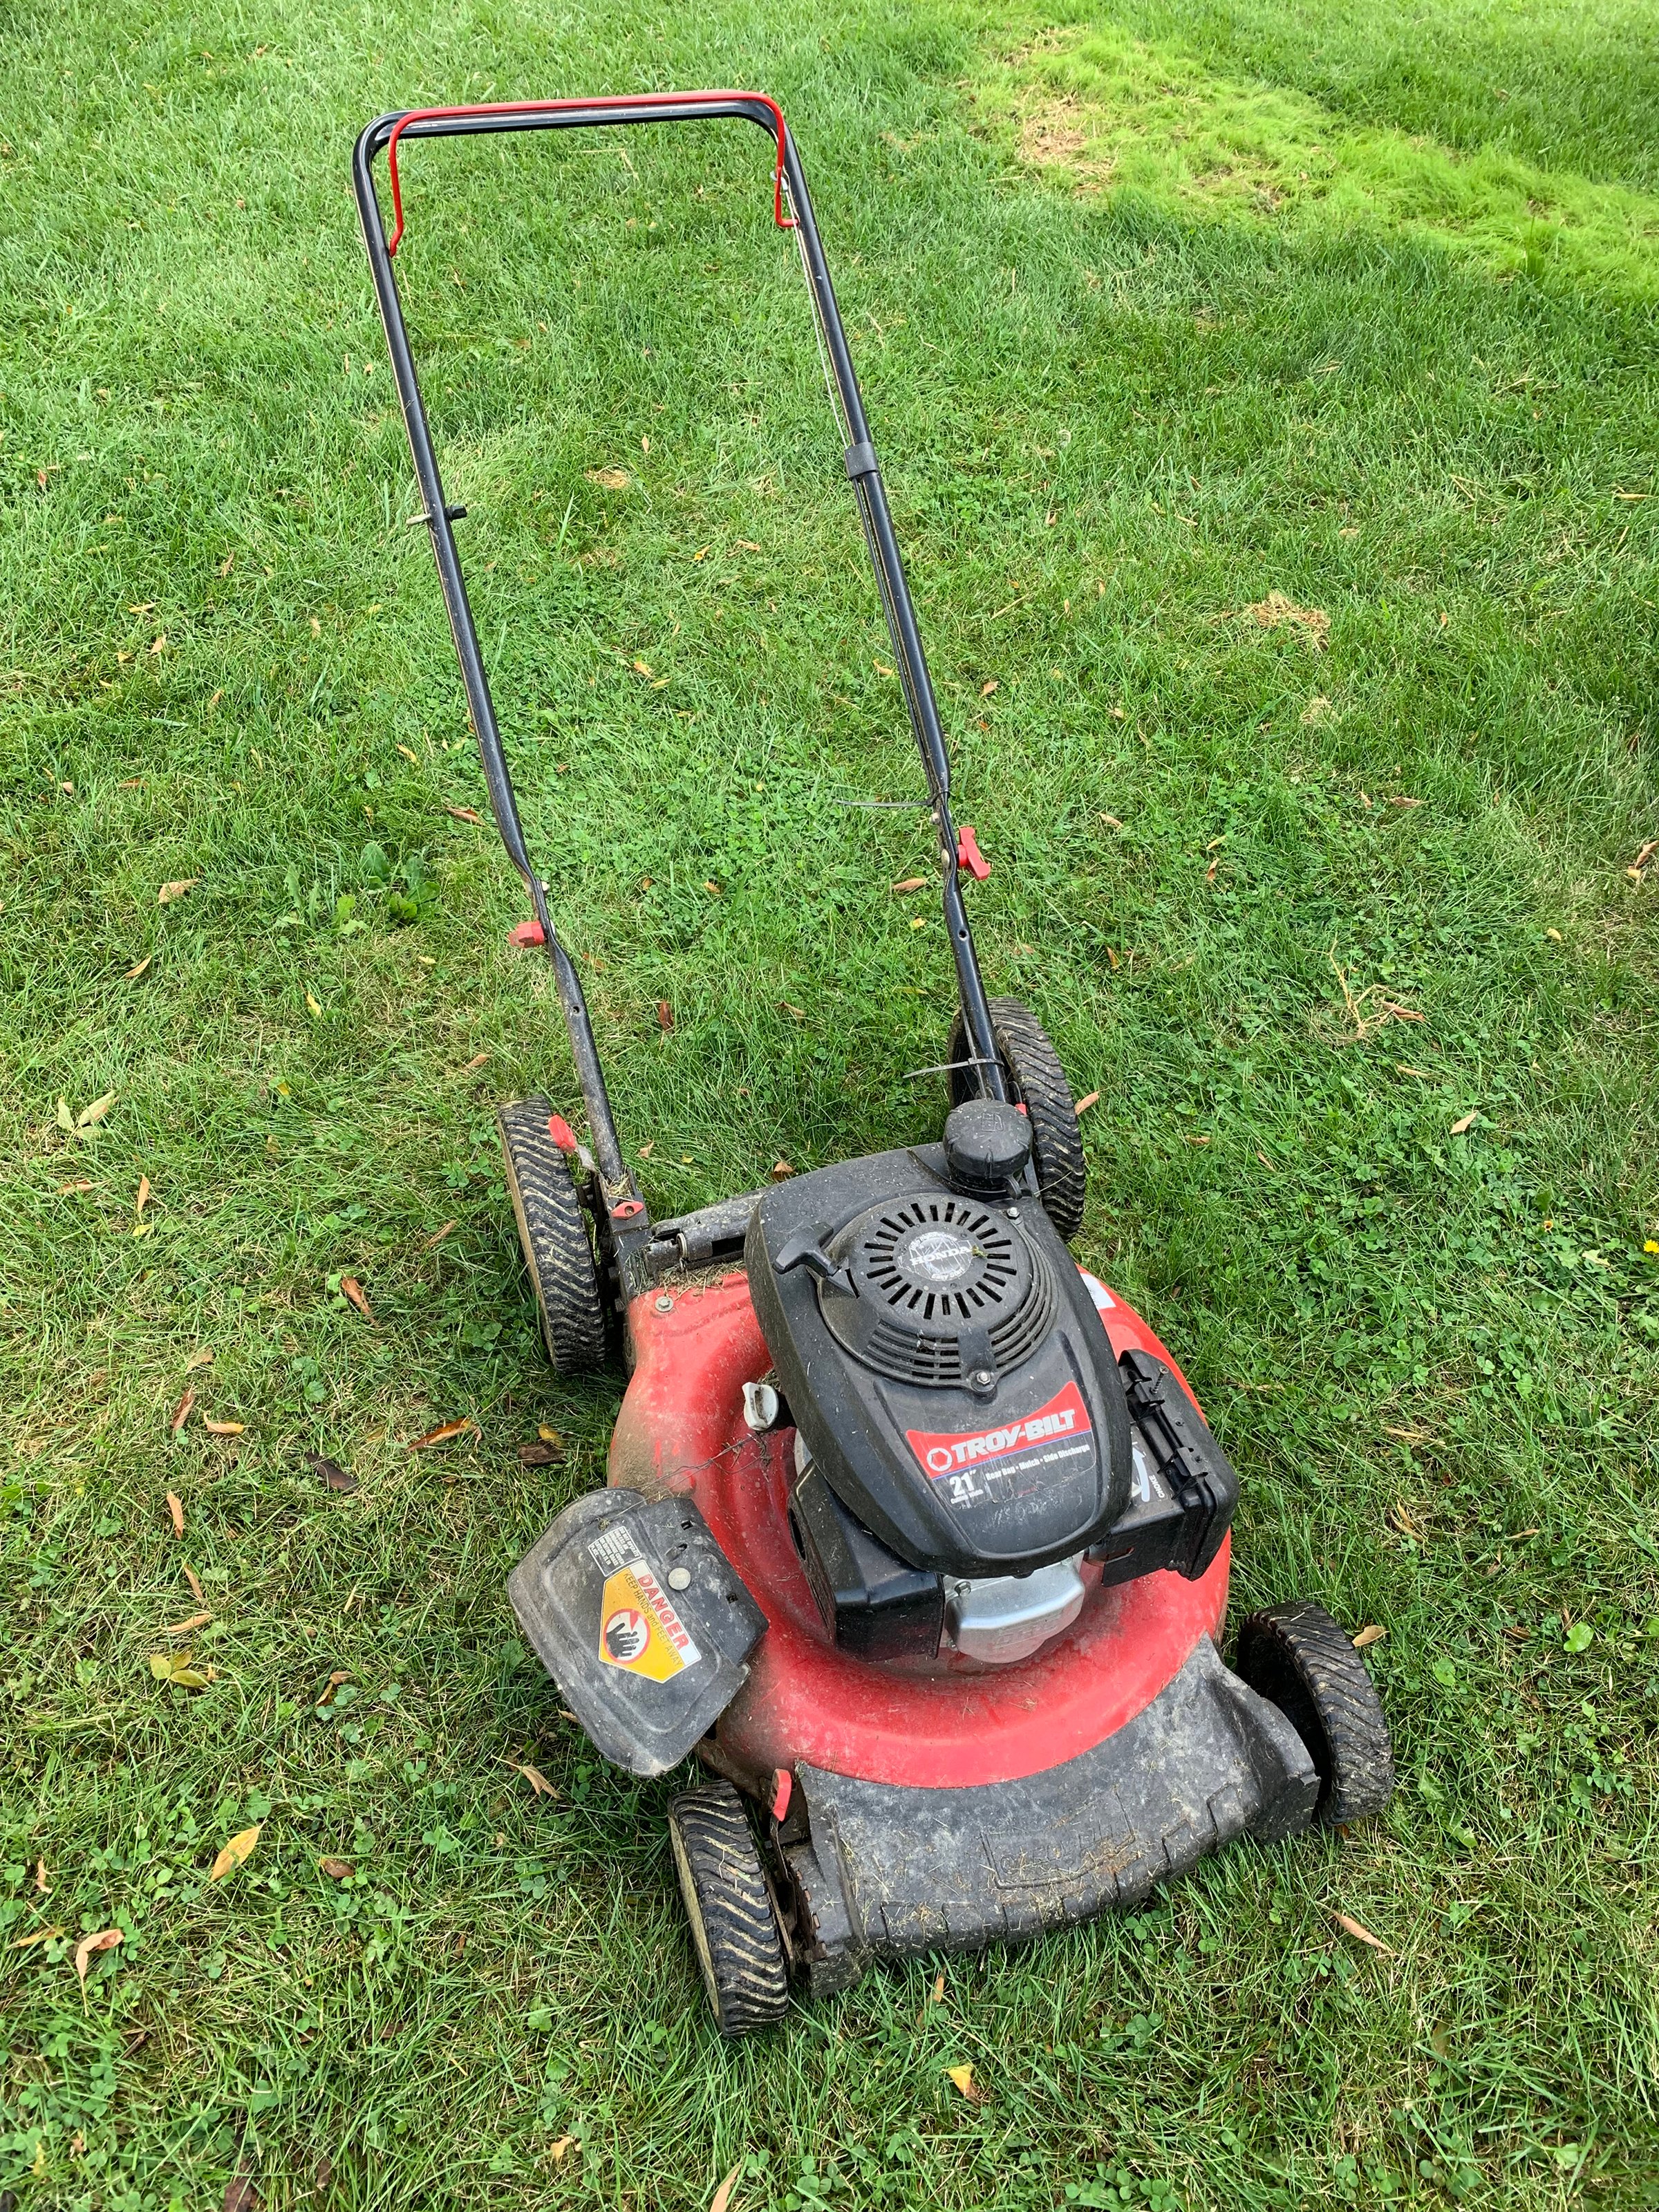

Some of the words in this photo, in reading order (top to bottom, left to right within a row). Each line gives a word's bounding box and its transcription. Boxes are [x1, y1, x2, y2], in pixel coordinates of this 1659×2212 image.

[910, 1246, 972, 1266] HONDA
[950, 1409, 1076, 1463] TROY-BILT
[985, 1470, 1002, 1481] Rear
[1002, 1465, 1016, 1476] Bag
[1018, 1458, 1040, 1470] Mulch
[1042, 1452, 1058, 1463] Side
[1058, 1443, 1090, 1459] Discharge
[1149, 1474, 1165, 1499] CHOKE
[624, 1572, 638, 1589] KEEP
[633, 1589, 651, 1614] HANDS
[647, 1613, 657, 1627] and
[657, 1624, 670, 1644] FEET
[665, 1645, 682, 1667] AWAY
[637, 1574, 689, 1651] DANGER
